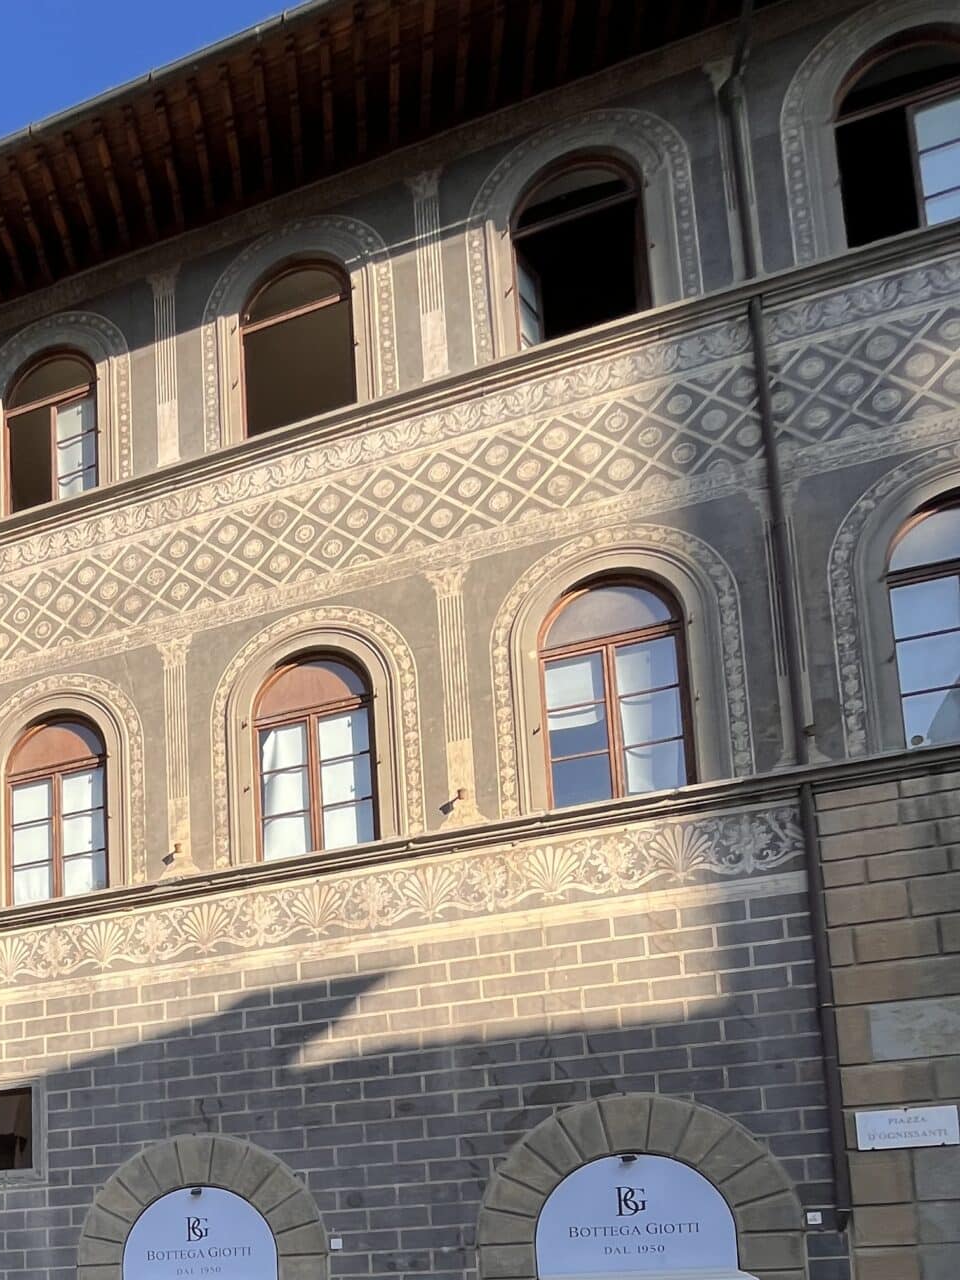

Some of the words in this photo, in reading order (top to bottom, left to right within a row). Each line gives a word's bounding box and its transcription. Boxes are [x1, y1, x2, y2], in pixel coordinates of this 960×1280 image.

[887, 1116, 928, 1126] PIAZZA
[568, 1225, 641, 1239] BOTTEGA
[645, 1221, 701, 1236] GIOTTI
[147, 1249, 205, 1261] BOTTEGA
[207, 1246, 252, 1258] GIOTTI
[603, 1245, 631, 1256] DAL
[637, 1244, 666, 1255] 1950
[176, 1267, 196, 1276] DAL
[200, 1266, 223, 1275] 1950
